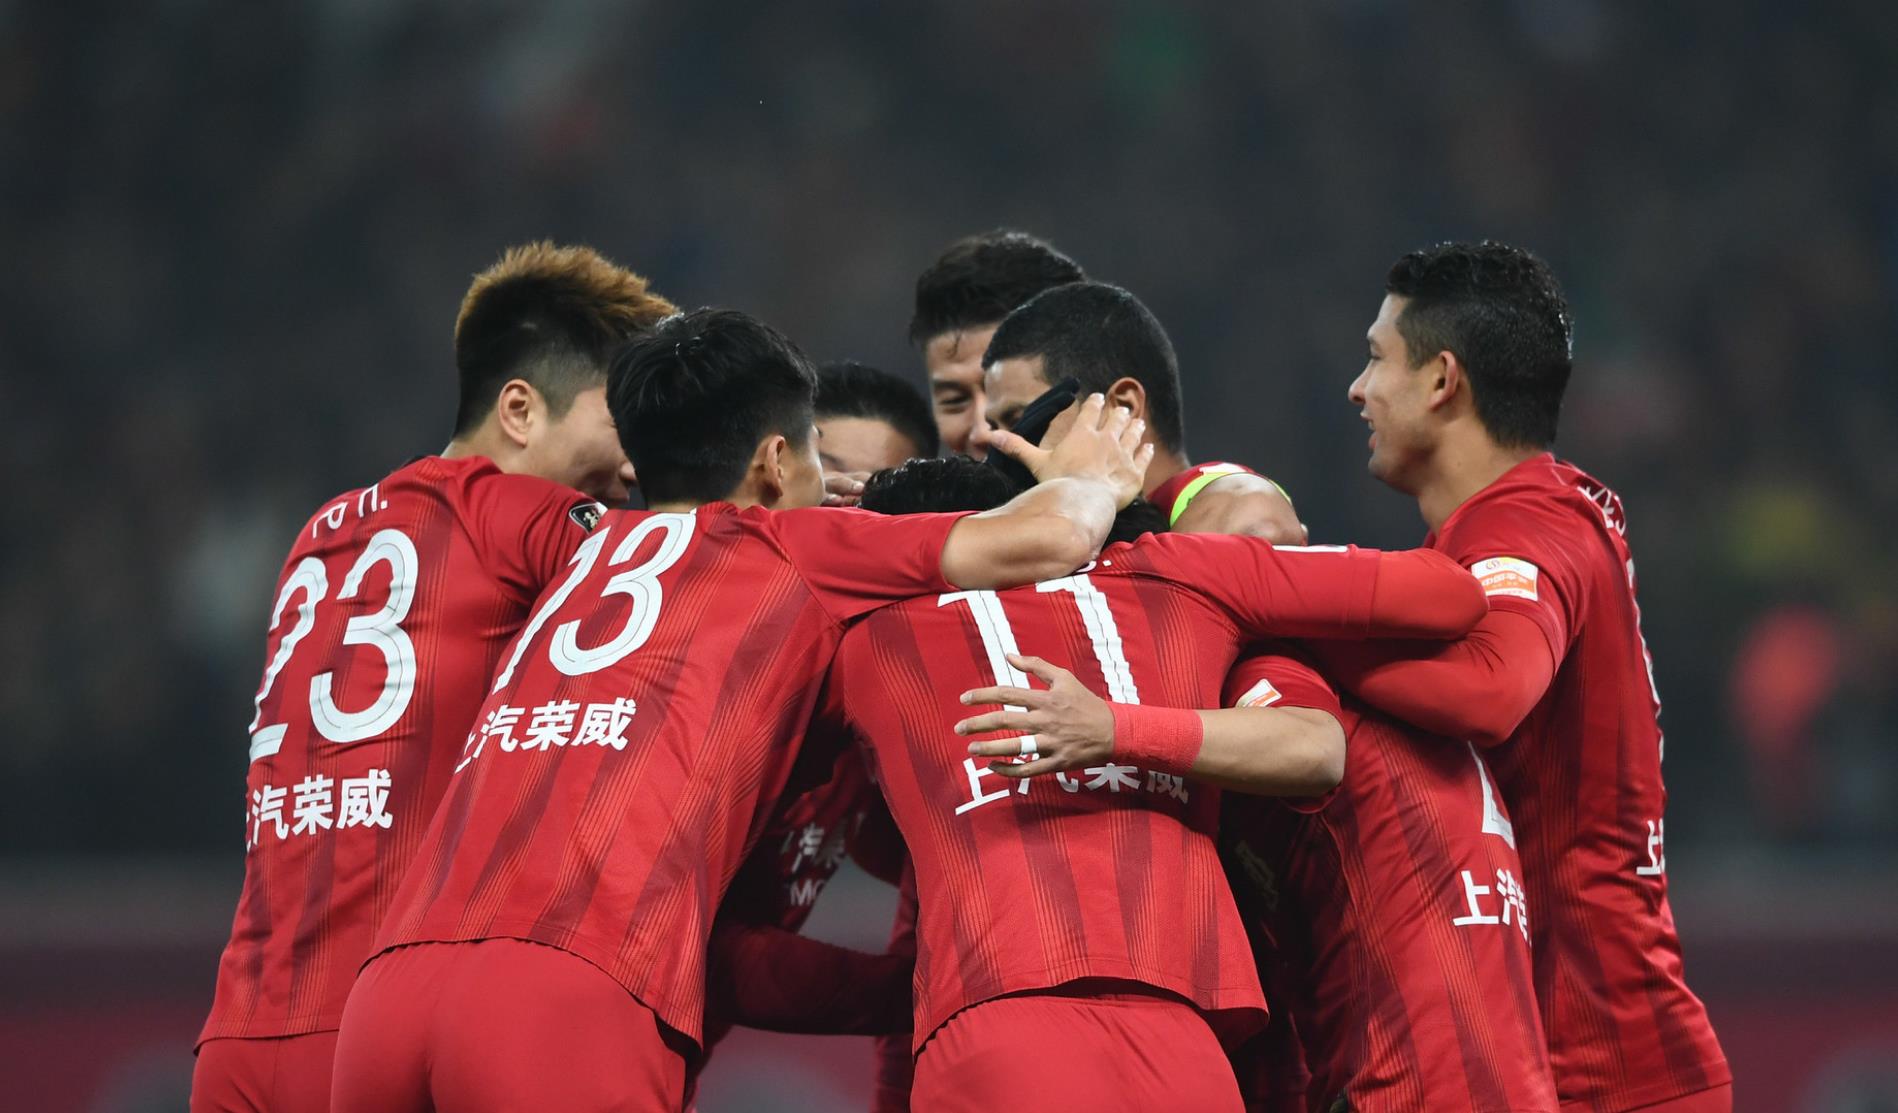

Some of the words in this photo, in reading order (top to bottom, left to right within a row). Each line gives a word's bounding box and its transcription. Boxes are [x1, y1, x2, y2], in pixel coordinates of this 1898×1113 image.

[249, 528, 418, 763] 23
[493, 508, 698, 696] 13
[937, 573, 1140, 713] 11
[246, 768, 394, 852] 汽荣威
